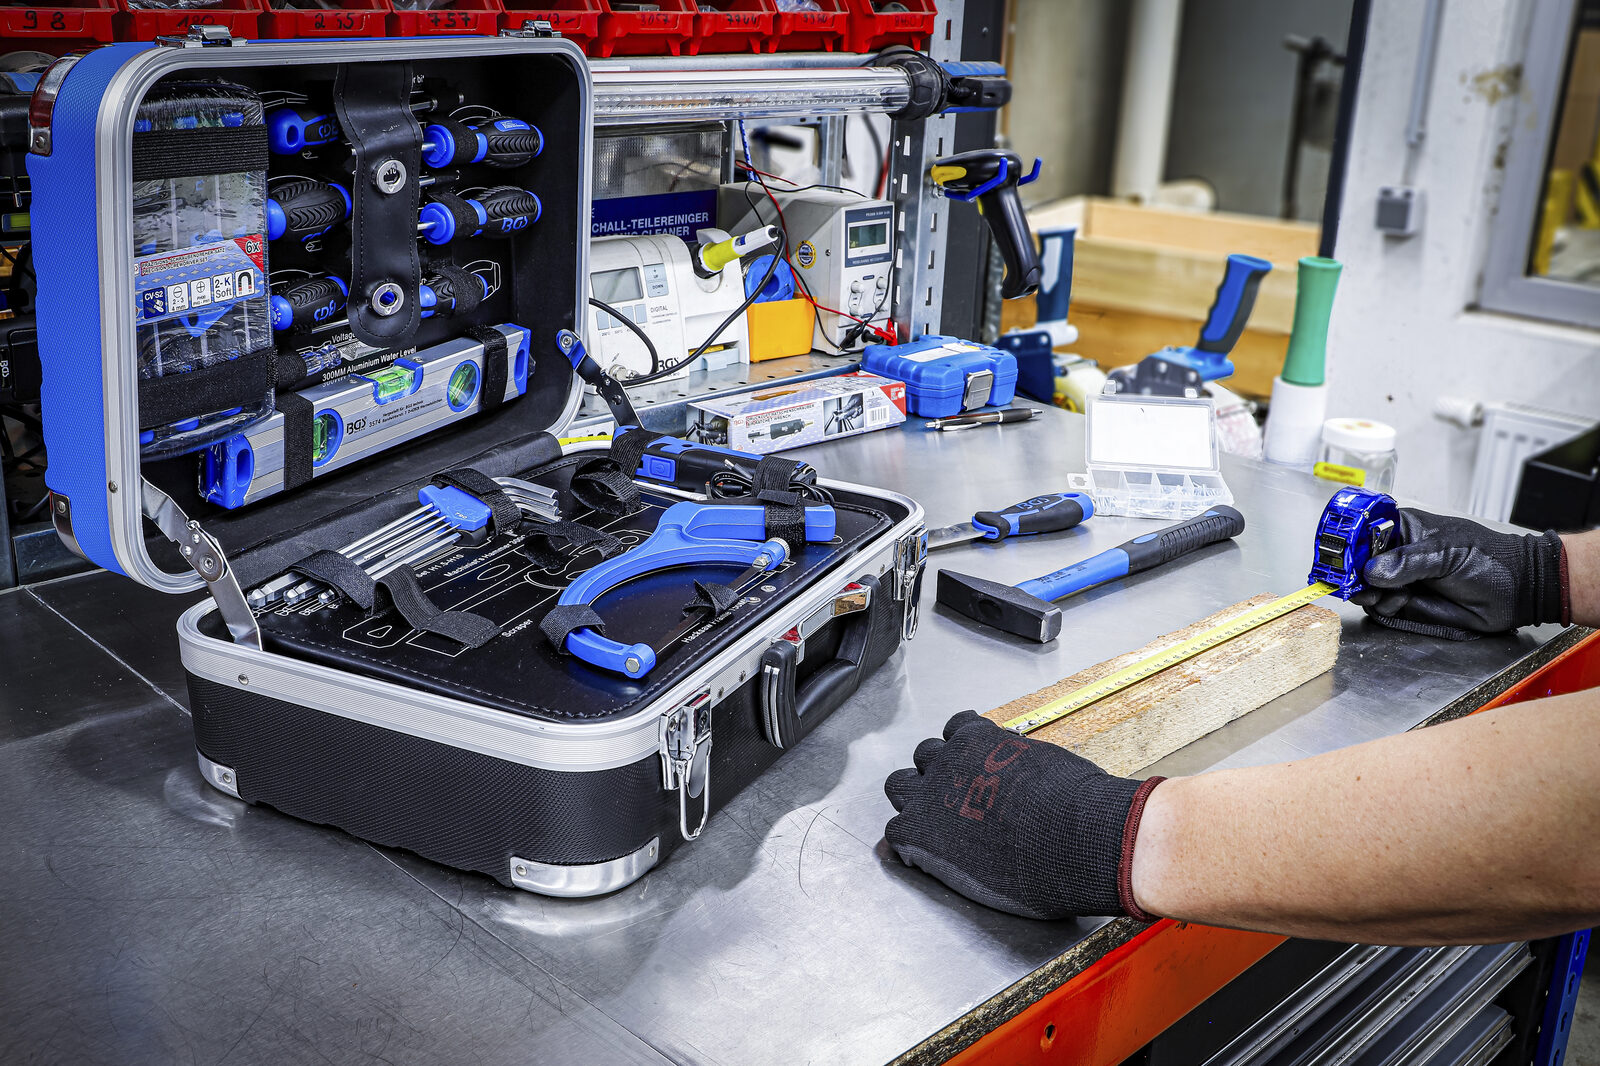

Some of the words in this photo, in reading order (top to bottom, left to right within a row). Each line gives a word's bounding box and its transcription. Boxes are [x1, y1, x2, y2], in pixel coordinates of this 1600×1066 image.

[502, 216, 528, 232] BGS
[245, 240, 261, 254] 6x
[144, 290, 164, 301] CV-S2
[215, 287, 232, 299] Soft
[650, 305, 668, 313] DIGITAL
[322, 367, 347, 382] 300MM
[346, 357, 380, 374] Aluminium
[380, 352, 399, 363] Water
[400, 346, 417, 358] Level
[1015, 497, 1050, 510] BGS
[501, 617, 534, 638] Scraper
